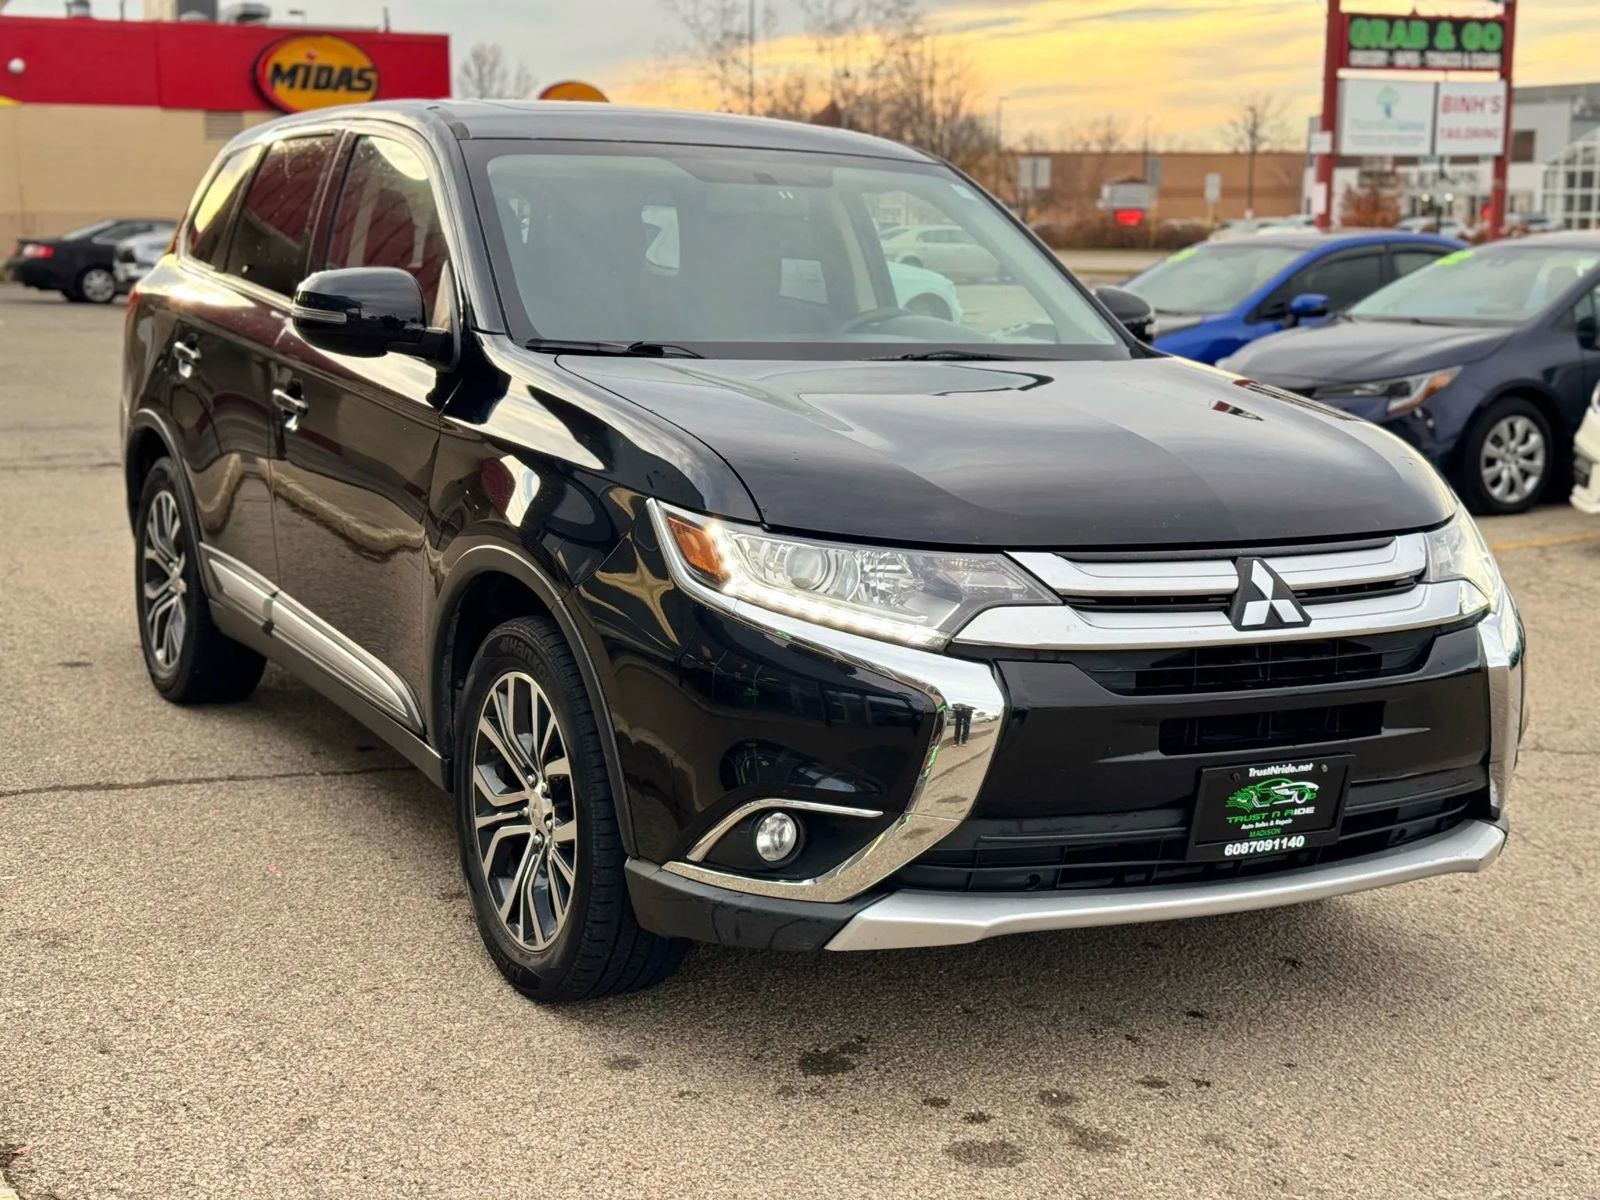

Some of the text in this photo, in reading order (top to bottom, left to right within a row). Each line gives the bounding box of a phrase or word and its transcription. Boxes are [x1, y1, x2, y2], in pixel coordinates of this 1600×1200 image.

[1433, 20, 1456, 50] &
[1461, 21, 1503, 51] GO
[271, 53, 377, 93] MIDAS
[1441, 94, 1502, 115] BINH'S
[1226, 812, 1269, 823] TRUST
[1249, 828, 1281, 837] MADISON
[1224, 835, 1305, 856] 6087091140
